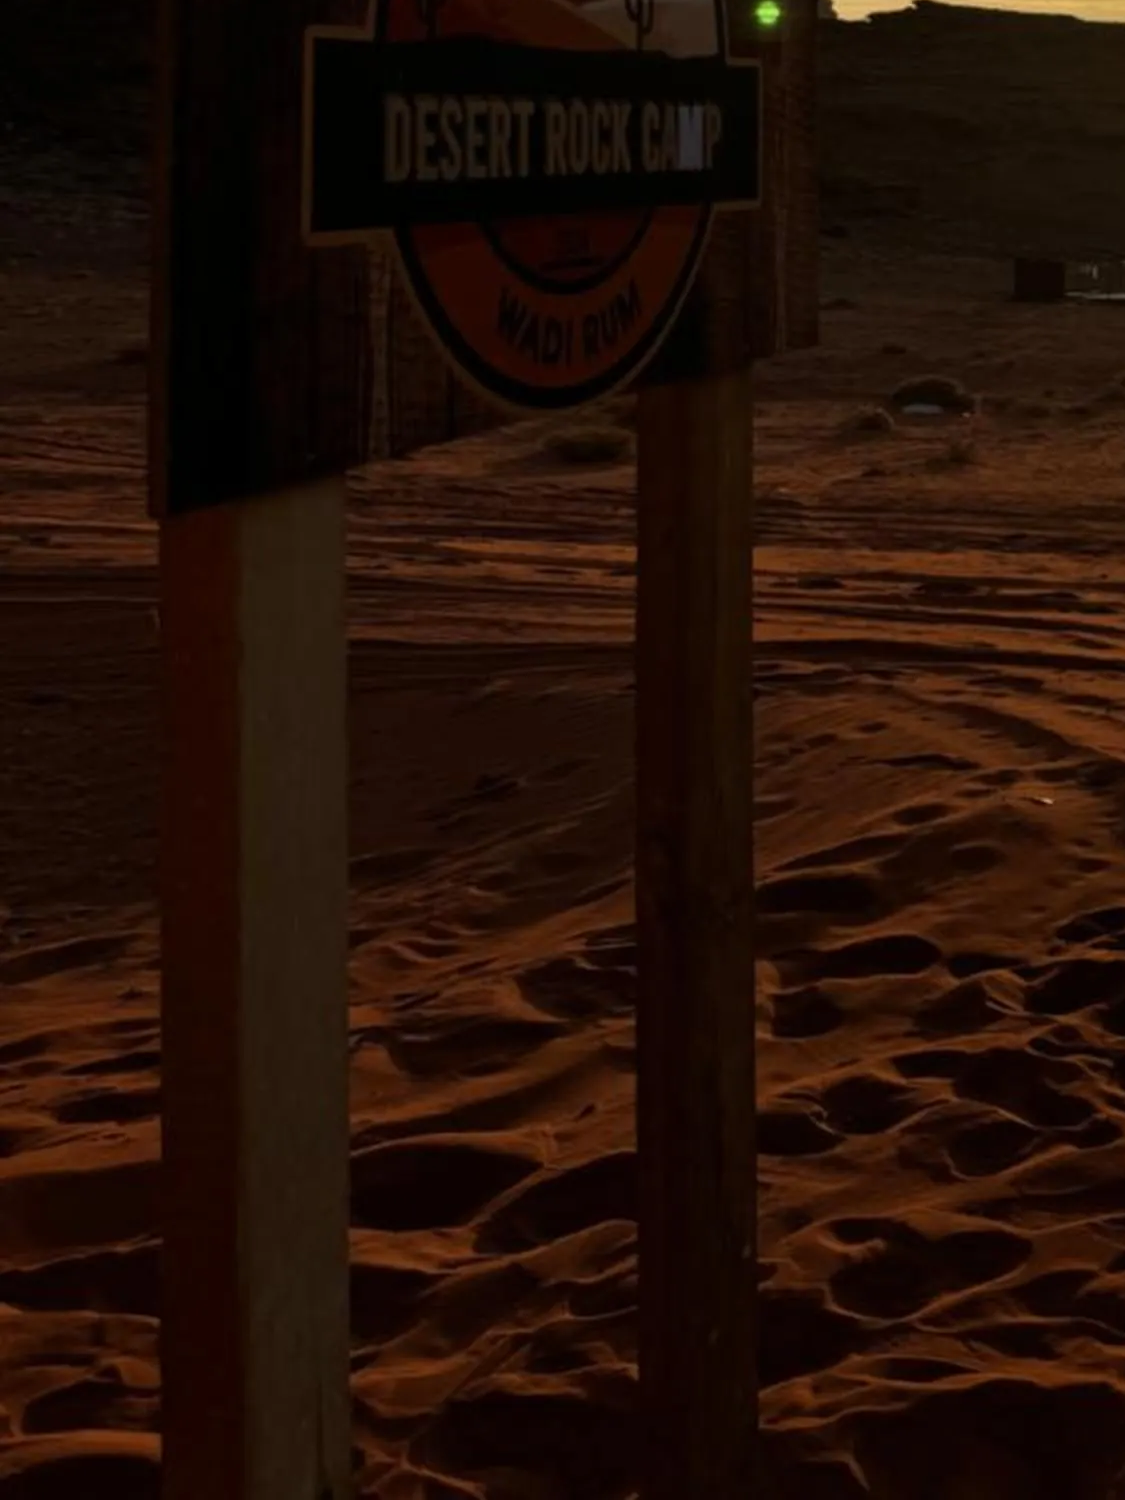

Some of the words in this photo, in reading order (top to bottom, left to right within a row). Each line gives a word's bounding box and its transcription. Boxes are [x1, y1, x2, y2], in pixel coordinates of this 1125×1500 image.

[384, 94, 535, 182] DESERT
[543, 98, 632, 176] ROCK
[641, 101, 722, 172] CAMP
[498, 287, 571, 367] WADI
[584, 278, 640, 362] RUM
